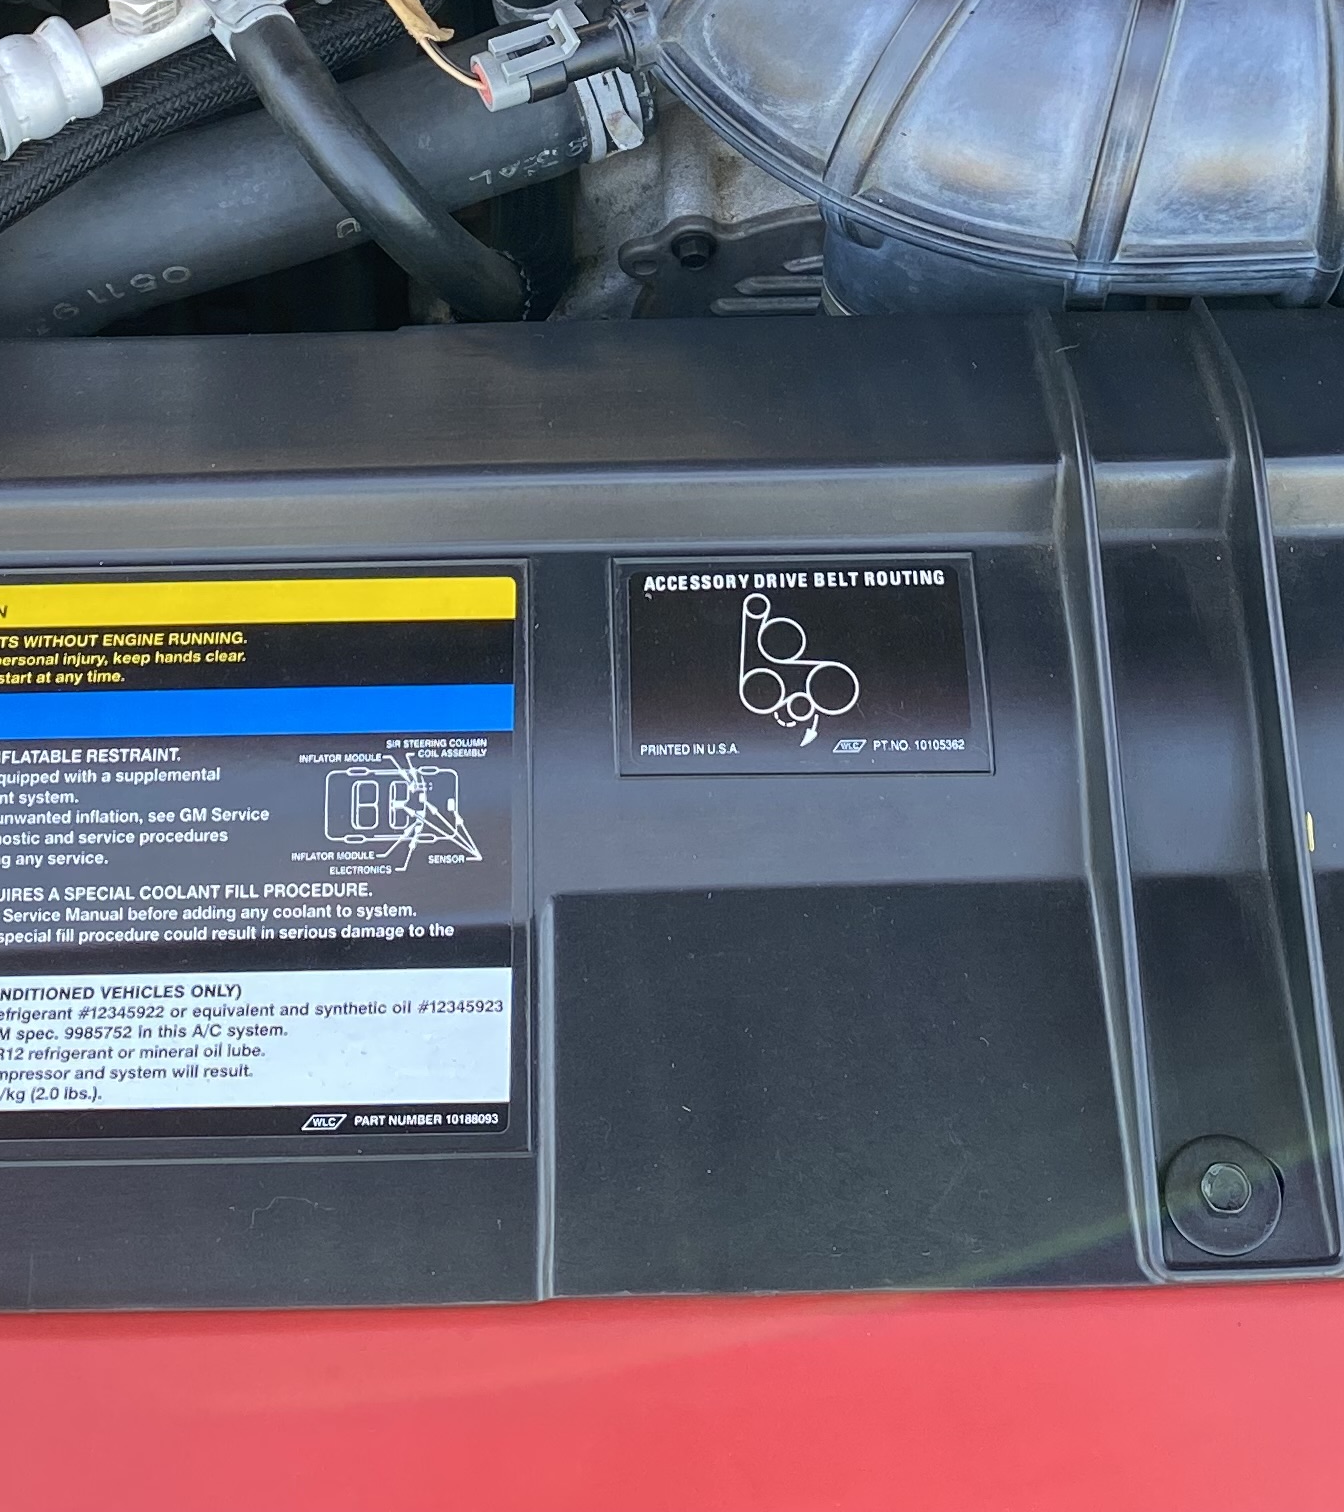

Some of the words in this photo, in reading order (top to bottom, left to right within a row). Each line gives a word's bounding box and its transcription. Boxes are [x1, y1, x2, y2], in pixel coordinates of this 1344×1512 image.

[644, 574, 749, 591] ACCESSORY
[754, 573, 807, 588] DRIVE
[814, 572, 859, 587] BELT
[864, 570, 944, 586] ROUTING
[24, 634, 99, 648] WITHOUT
[102, 633, 165, 646] ENGINE
[168, 631, 247, 645] RUNNING.
[63, 652, 108, 667] injury,
[113, 652, 150, 666] keep
[155, 650, 201, 664] hands
[205, 650, 246, 662] clear.
[418, 749, 439, 758] COIL
[441, 748, 487, 757] ASSEMBLY
[640, 744, 690, 756] PRINTED
[693, 744, 704, 755] IN
[707, 743, 739, 755] U.S.A.
[873, 740, 911, 751] PT.NO.
[915, 739, 965, 751] 10105362
[86, 747, 181, 763] RESTRAINT.
[428, 855, 464, 864] SENSOR
[330, 865, 392, 875] ELECTRONICS
[48, 887, 60, 901] A
[64, 886, 135, 901] SPECIAL
[139, 885, 221, 900] COOLANT
[225, 884, 259, 899] FILL
[264, 882, 373, 898] PROCEDURE.
[101, 985, 185, 999] VEHICLES
[191, 984, 242, 1000] ONLY)
[31, 1087, 59, 1103] (2.0
[64, 1086, 102, 1103] lbs.).
[354, 1115, 386, 1126] PART
[388, 1114, 442, 1126] NUMBER
[446, 1113, 499, 1124] 10188093
